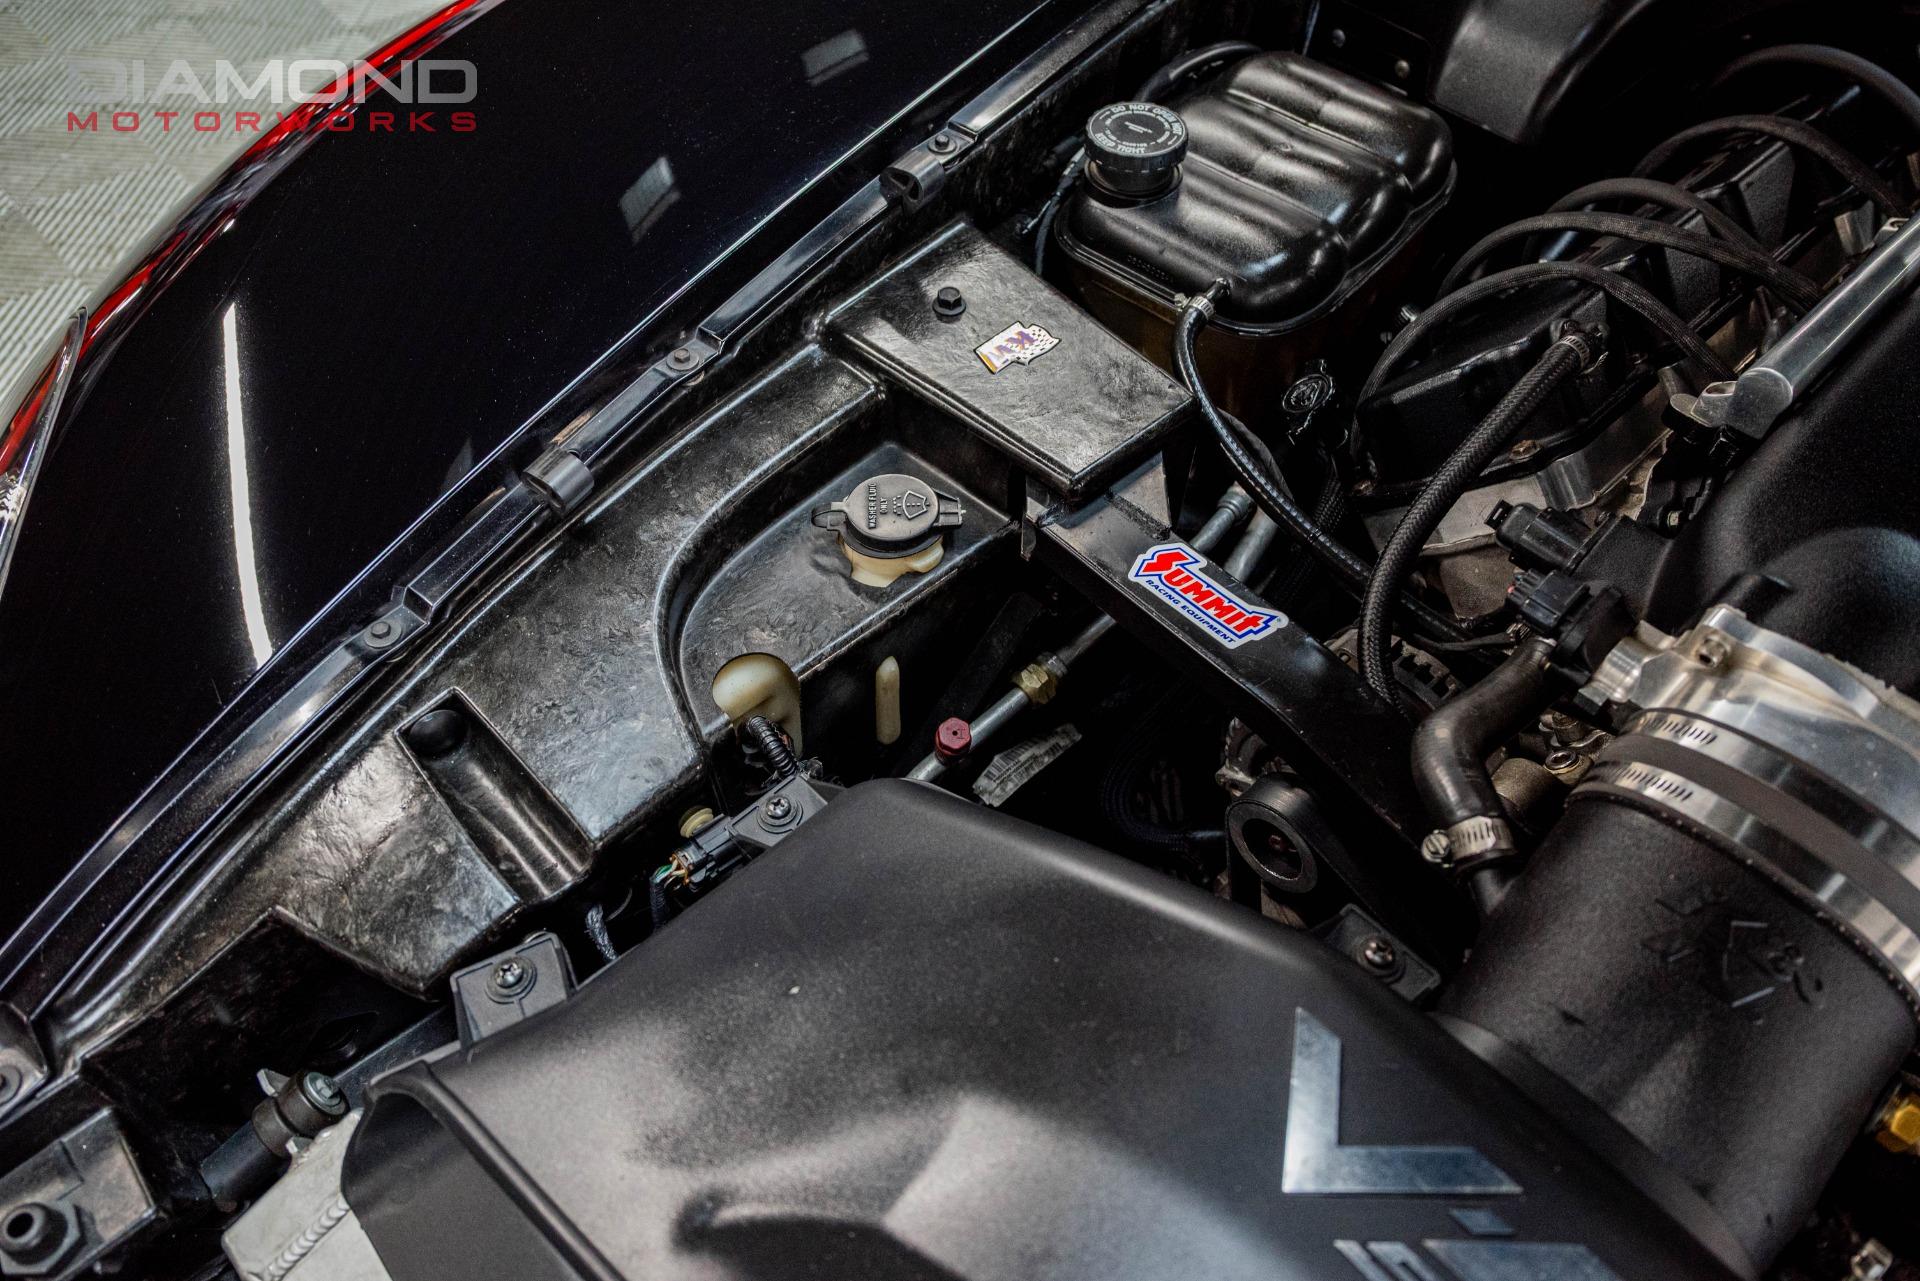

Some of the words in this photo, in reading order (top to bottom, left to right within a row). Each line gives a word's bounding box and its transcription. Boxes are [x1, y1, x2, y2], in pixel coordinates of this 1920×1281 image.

[1110, 105, 1126, 113] DO
[1094, 132, 1116, 147] KEEP
[1116, 144, 1146, 154] TIGHT
[868, 502, 877, 529] WASHER
[880, 498, 888, 514] ONLY
[1145, 578, 1181, 605] RACING
[1181, 604, 1237, 644] EQUIPMENT
